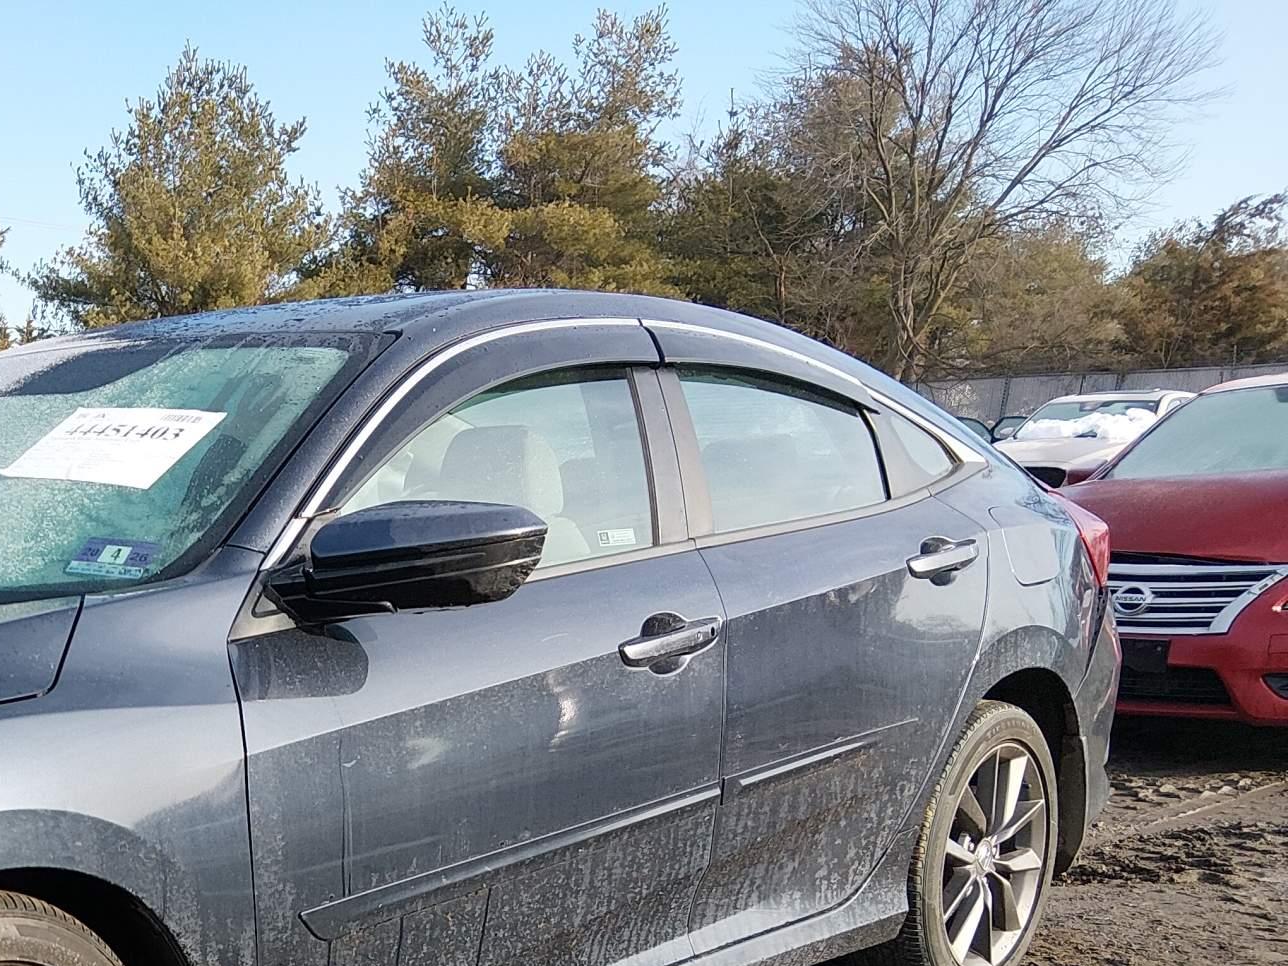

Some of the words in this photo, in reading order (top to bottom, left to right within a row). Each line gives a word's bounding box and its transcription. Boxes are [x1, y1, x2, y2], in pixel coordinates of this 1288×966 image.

[65, 423, 185, 440] 44451403
[111, 548, 123, 561] 4
[129, 552, 149, 562] 26
